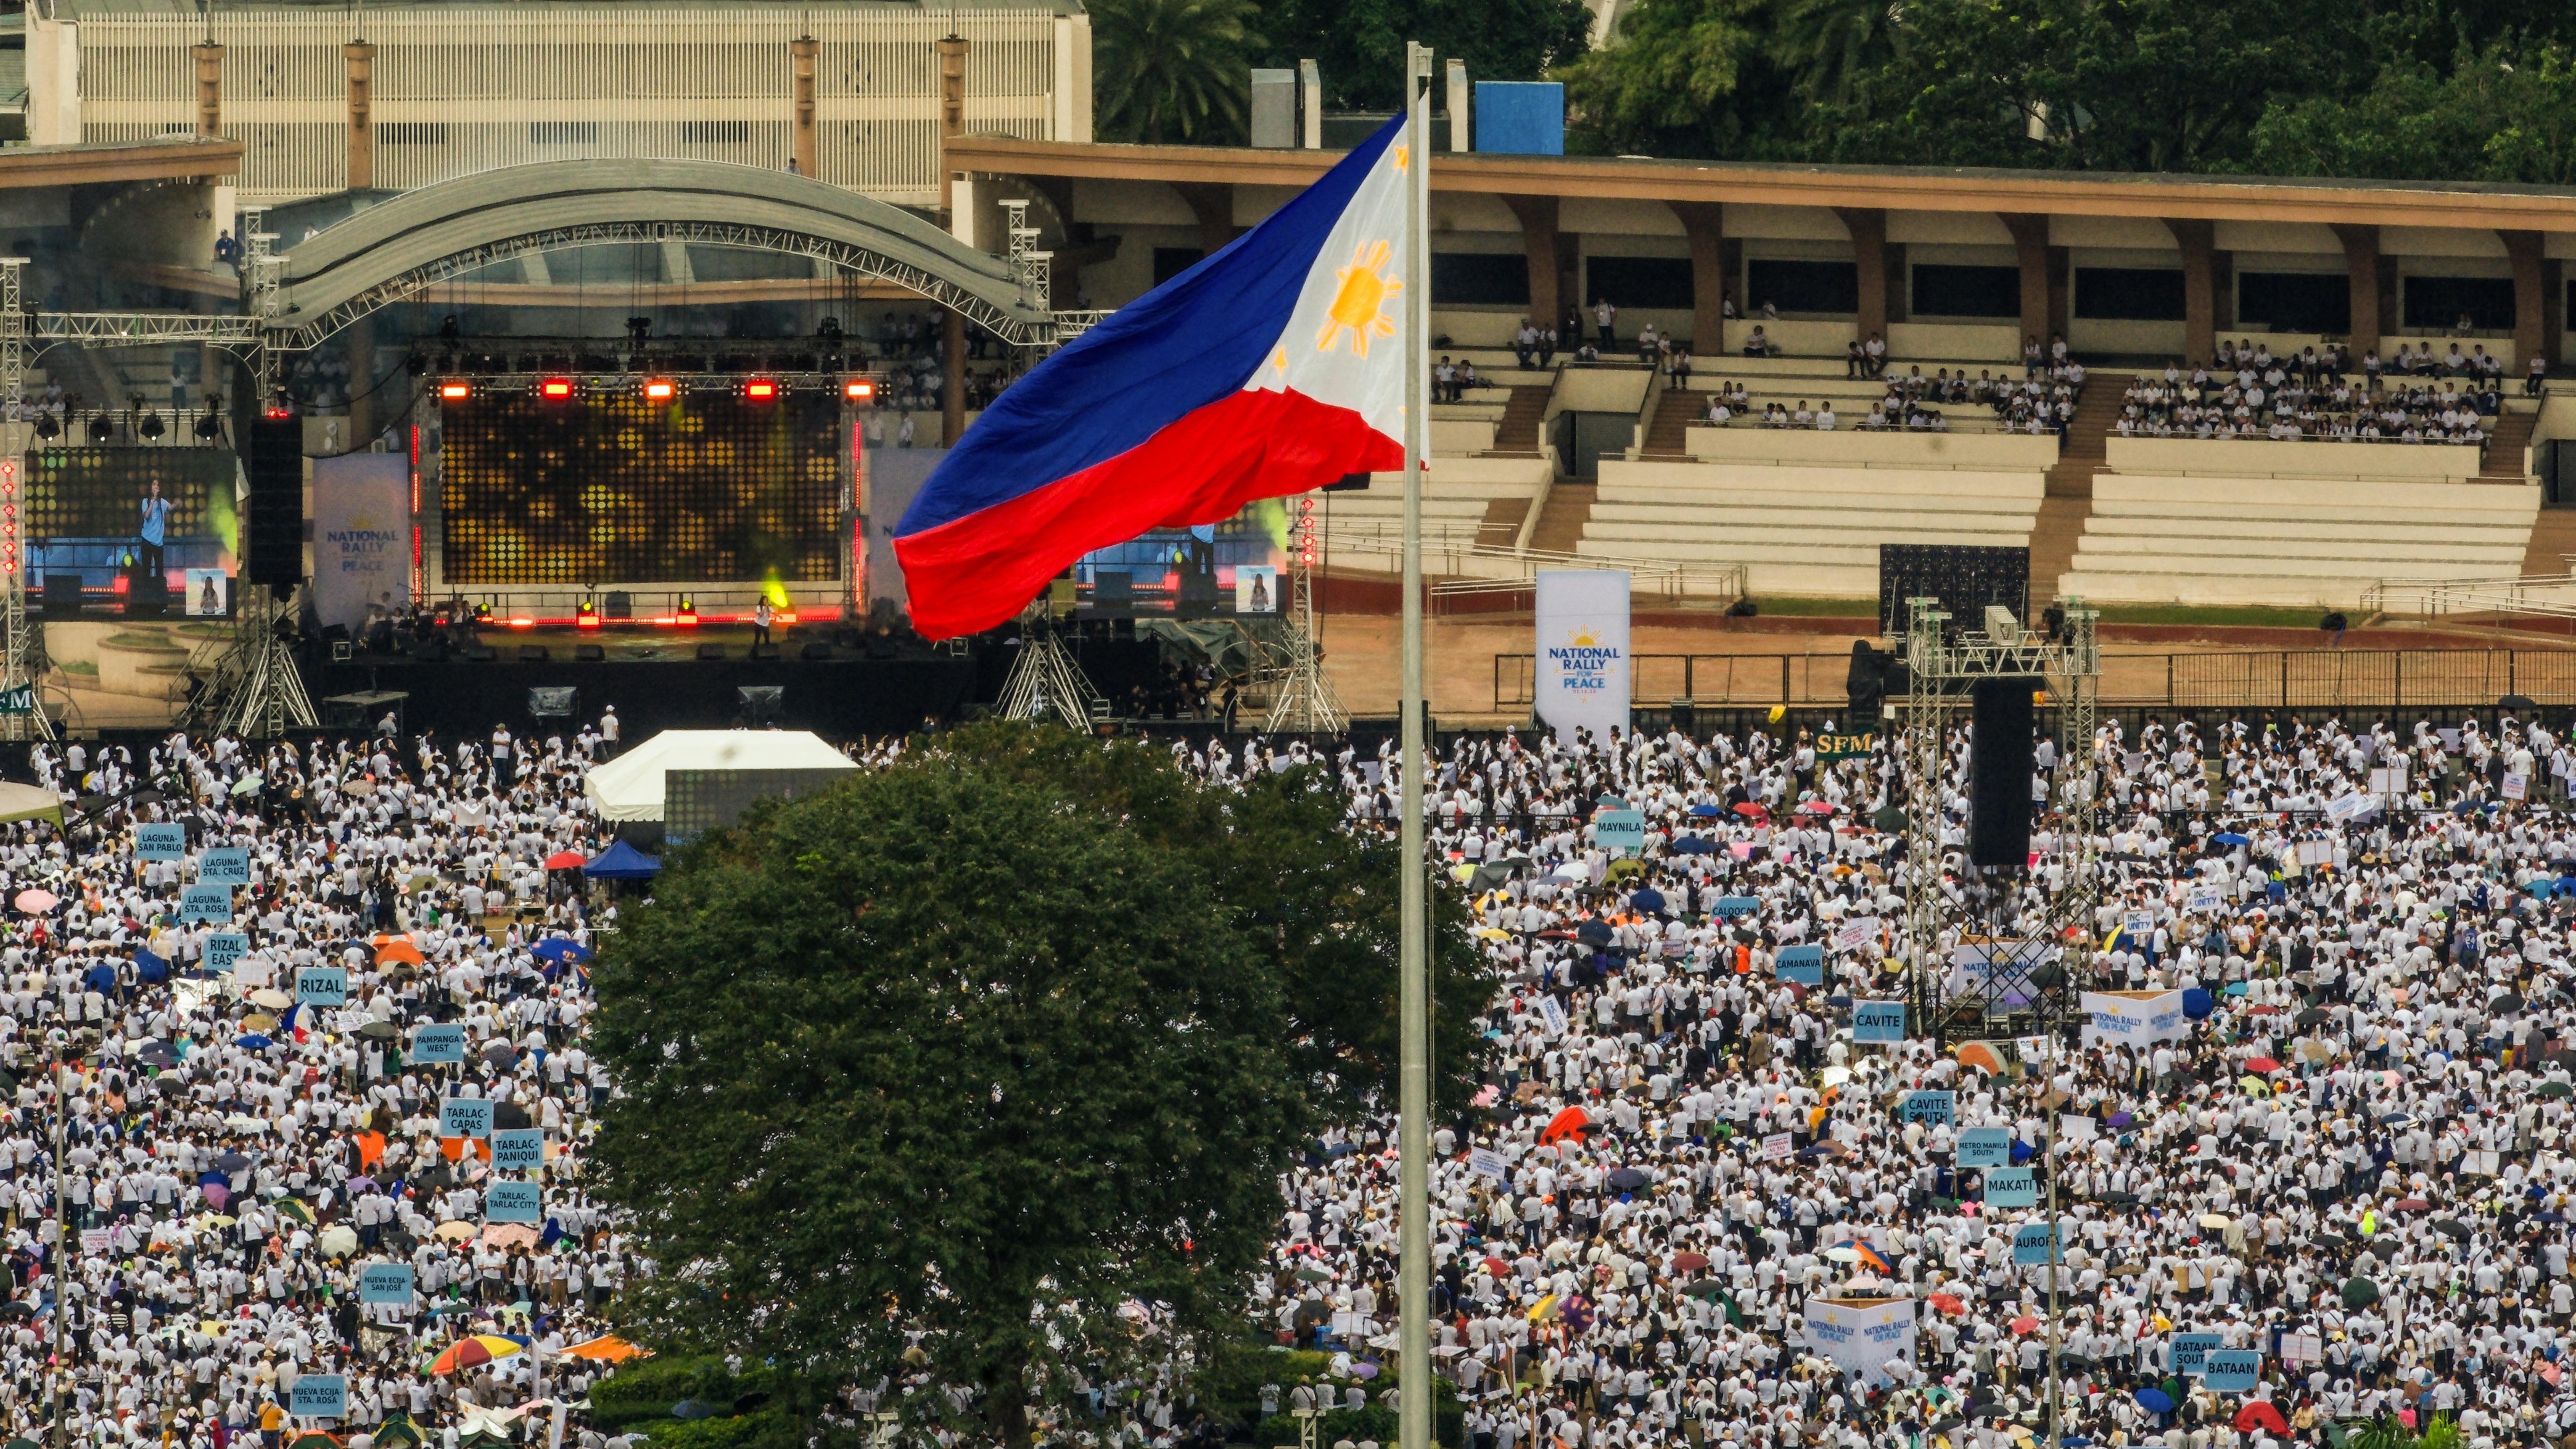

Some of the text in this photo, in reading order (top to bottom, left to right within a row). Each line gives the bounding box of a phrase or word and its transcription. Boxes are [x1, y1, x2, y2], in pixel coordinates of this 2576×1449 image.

[327, 530, 399, 542] NATIONAL
[341, 542, 385, 553] RALLY
[342, 560, 383, 571] PEACE
[1549, 648, 1620, 658] NATIONAL
[1563, 660, 1606, 670] RALLY
[1564, 678, 1604, 689] PEACE
[1817, 733, 1872, 753] SFM
[1598, 823, 1641, 832] MAYNILA
[142, 834, 178, 843] LAGUNA-
[138, 843, 182, 852] SAN PABLO
[203, 867, 245, 877] STA. CRUZ
[188, 895, 225, 904] LAGUNA-
[2193, 890, 2206, 899] INC
[2195, 897, 2217, 907] UNITY
[184, 905, 228, 914] STA. ROSA
[2128, 921, 2150, 930] UNITY
[210, 940, 242, 952] RIZAL
[1775, 959, 1821, 968] CAMANAVA
[301, 979, 343, 993] RIZAL
[1547, 1000, 1557, 1012] INC
[2091, 1012, 2142, 1027] ATIONAL RALLY
[2169, 1009, 2181, 1020] RALLY
[1856, 1014, 1900, 1027] CAVITE
[2097, 1020, 2112, 1030] FOR
[2114, 1022, 2131, 1034] PEACE
[417, 1035, 460, 1044] PAMPANGA
[1909, 1098, 1948, 1110] CAVITE
[447, 1108, 488, 1118] TARLAC-
[451, 1120, 482, 1130] CAPAS
[496, 1139, 538, 1150] TARLAC-
[497, 1151, 539, 1162] PANIQUI
[1988, 1179, 2032, 1191] MAKATI
[1807, 1319, 1855, 1337] NATIONAL RALLY
[1864, 1319, 1911, 1337] NATIONAL RALLY
[1817, 1330, 1829, 1339] FOR
[1829, 1332, 1845, 1343] PEACE
[1873, 1333, 1885, 1343] FOR
[1885, 1331, 1901, 1341] PEACE
[2175, 1342, 2215, 1352] BATAAN
[2176, 1354, 2205, 1364] SOUT
[2208, 1362, 2255, 1374] BATAAN
[320, 1388, 342, 1396] ECIJA-
